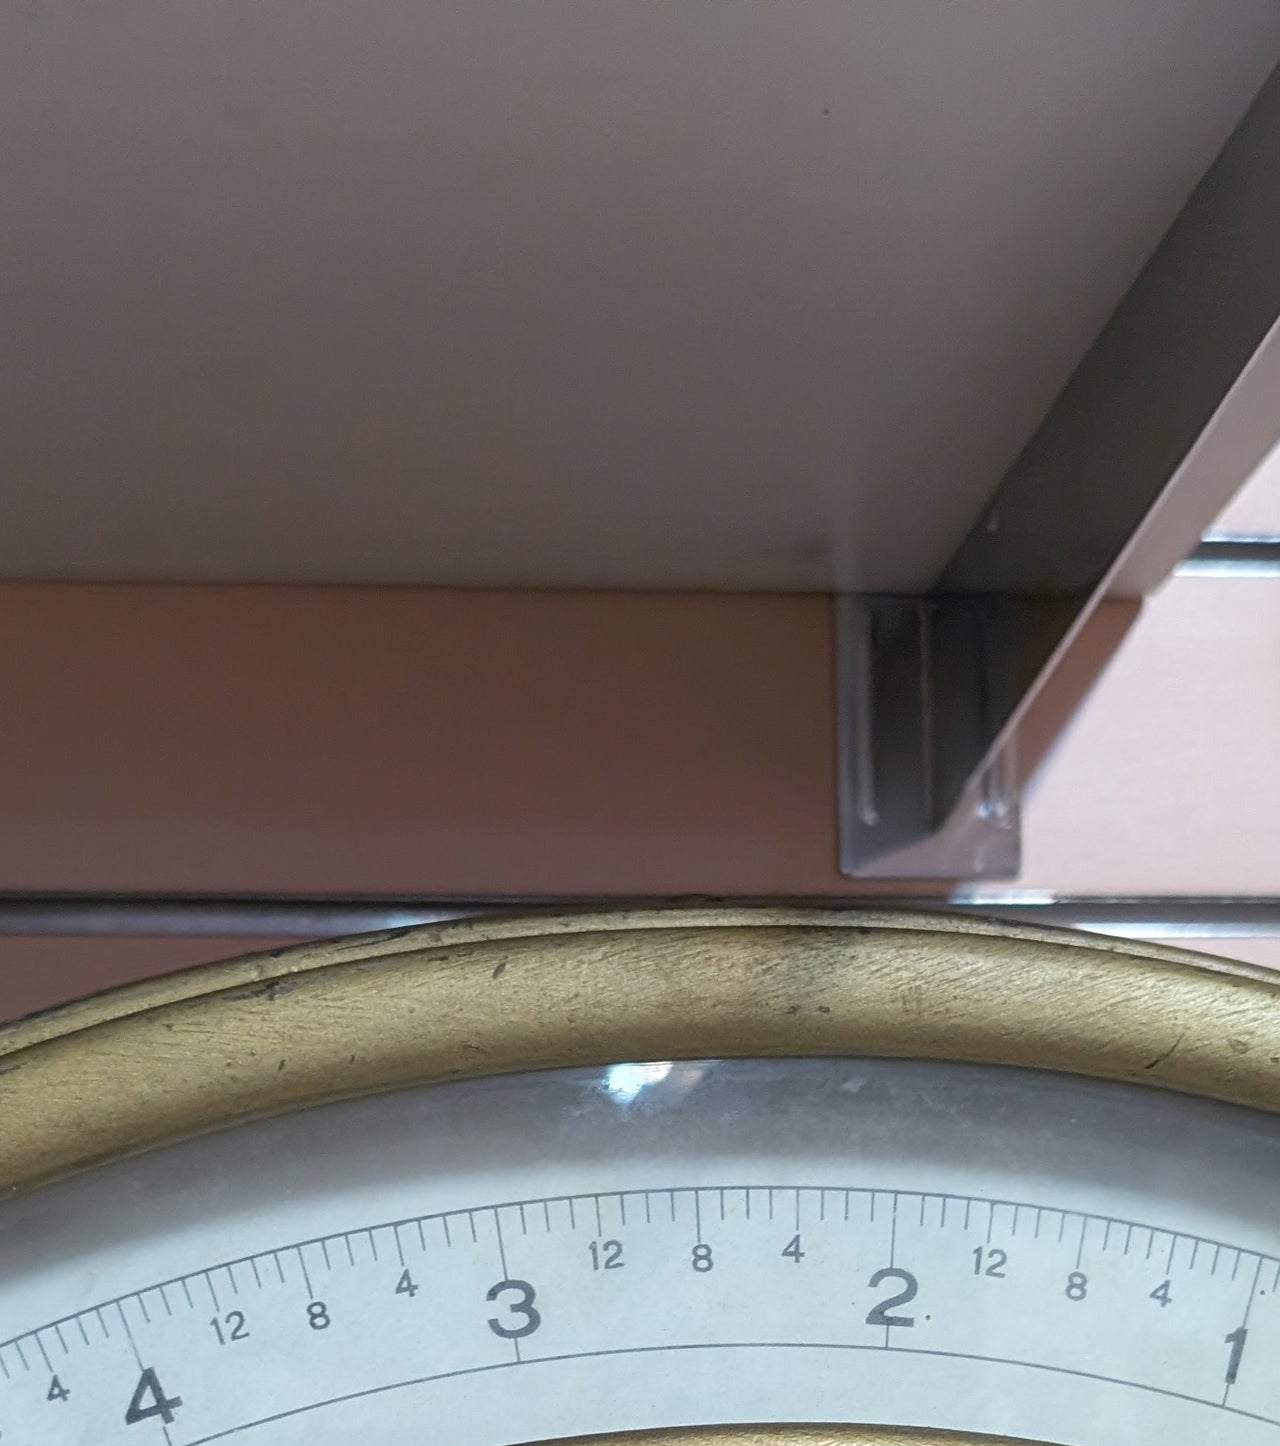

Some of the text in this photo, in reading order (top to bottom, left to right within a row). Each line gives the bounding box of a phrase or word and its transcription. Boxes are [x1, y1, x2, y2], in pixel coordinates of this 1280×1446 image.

[46, 1374, 71, 1403] 4
[125, 1367, 181, 1426] 4
[210, 1311, 251, 1345] 12
[308, 1302, 331, 1330] 8
[394, 1269, 418, 1298] 4
[485, 1279, 542, 1341] 3
[589, 1241, 625, 1271] 12
[691, 1244, 714, 1273] 8
[782, 1235, 805, 1262] 4
[865, 1267, 920, 1327] 2
[972, 1247, 1008, 1278] 12
[1065, 1271, 1088, 1302] 8
[1149, 1279, 1173, 1309] 4
[1224, 1327, 1249, 1385] 1
